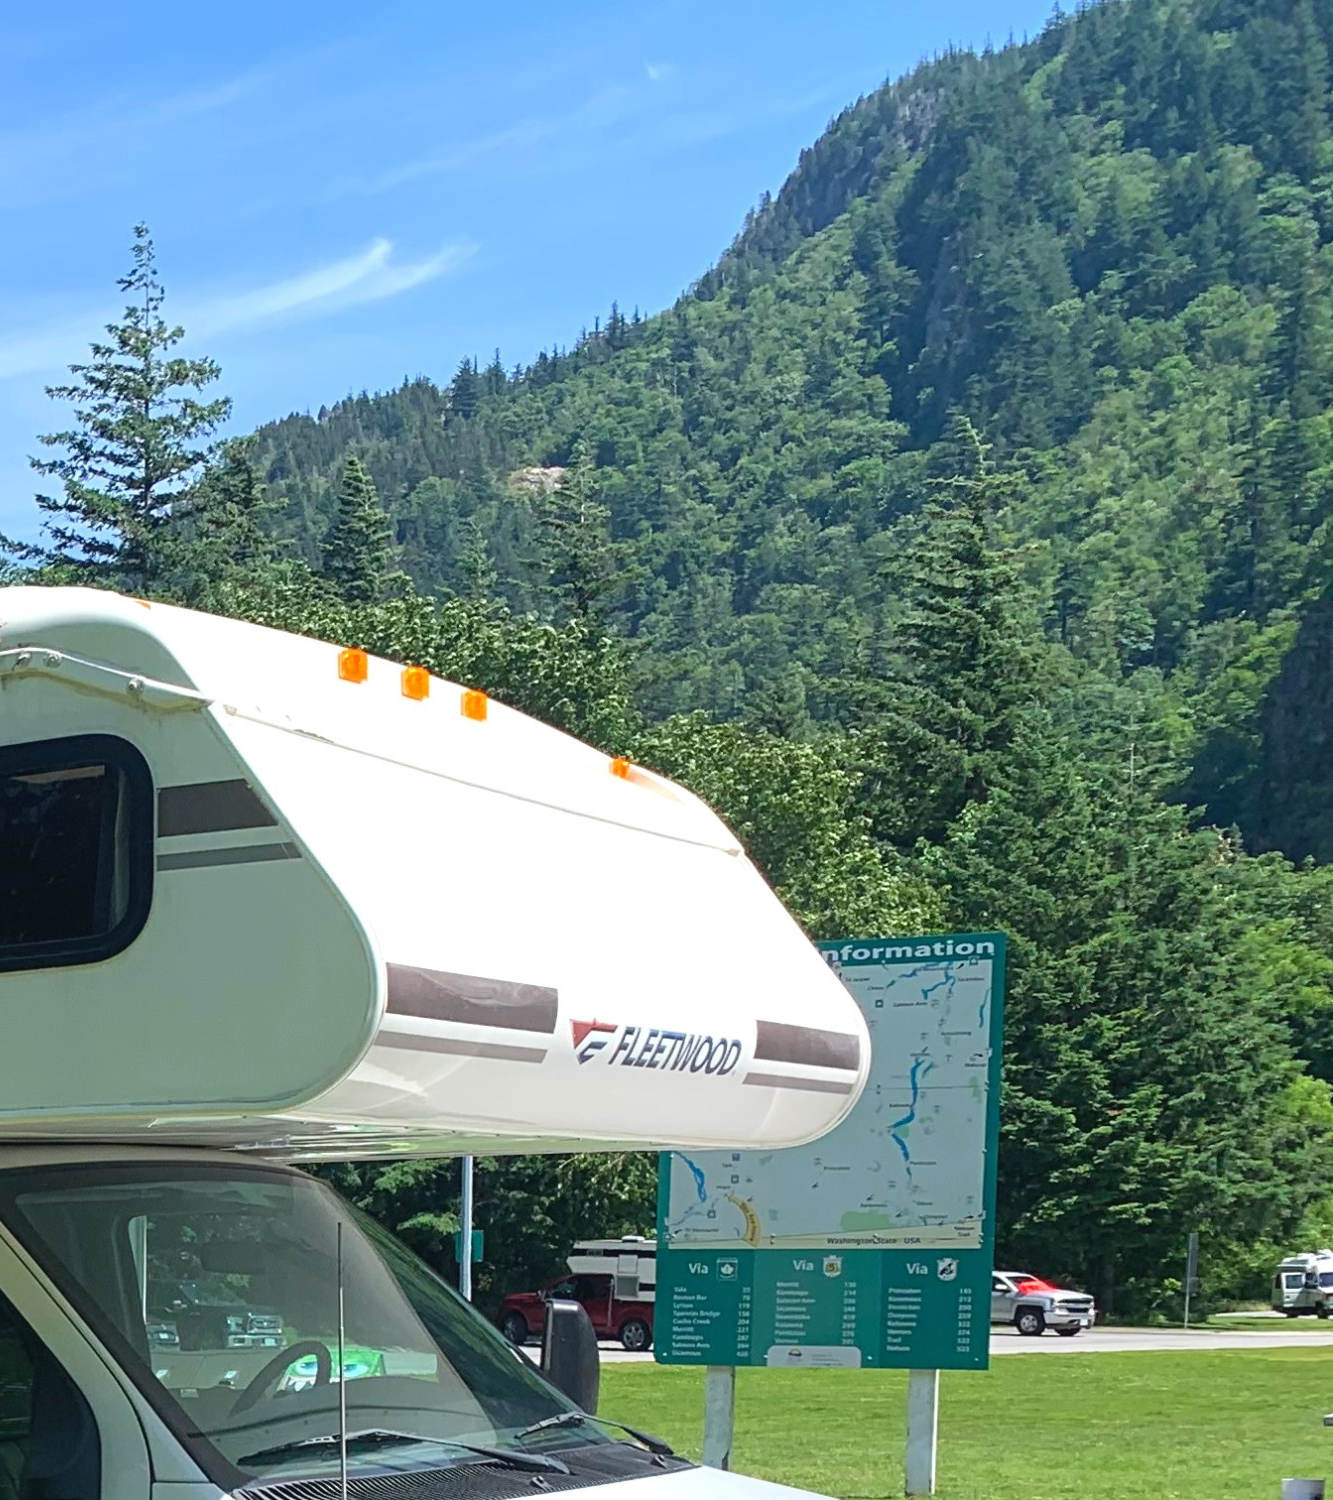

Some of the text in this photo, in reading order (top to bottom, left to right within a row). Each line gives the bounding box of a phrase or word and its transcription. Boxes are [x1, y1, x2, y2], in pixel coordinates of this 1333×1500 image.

[608, 1026, 742, 1076] FLEETWOOD
[827, 1237, 875, 1245] Washington
[688, 1263, 709, 1274] Via
[793, 1260, 814, 1271] Via
[906, 1263, 928, 1275] Via
